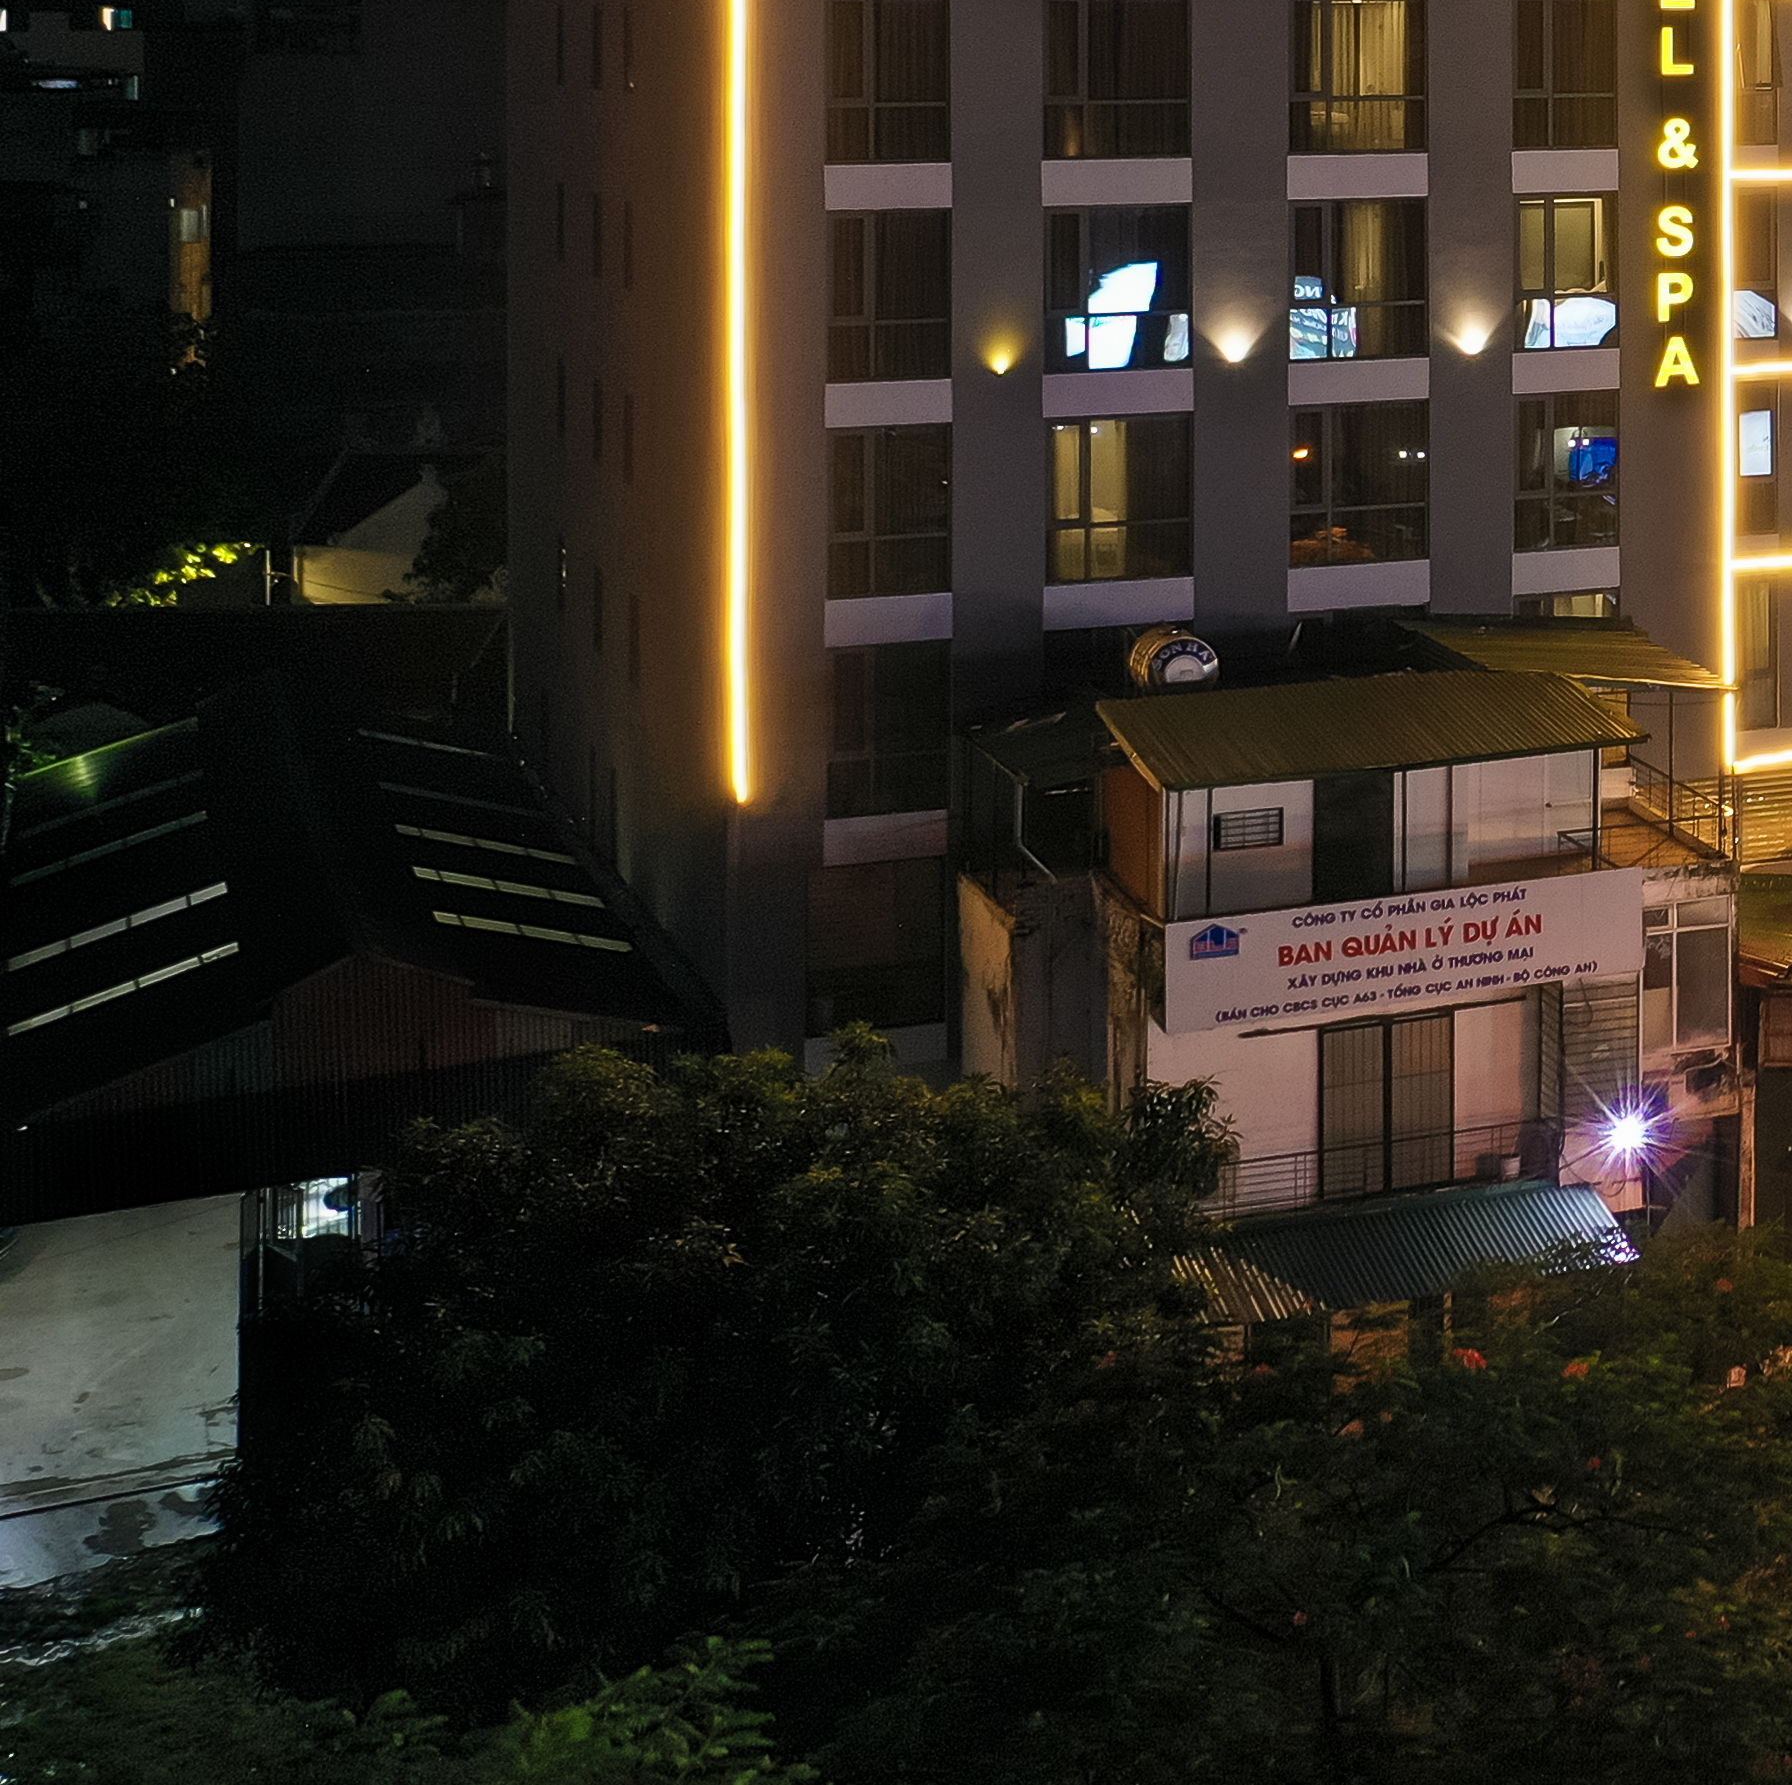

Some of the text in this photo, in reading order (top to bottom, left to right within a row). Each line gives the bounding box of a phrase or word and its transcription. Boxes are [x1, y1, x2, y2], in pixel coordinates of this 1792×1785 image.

[1656, 117, 1700, 170] &
[1655, 205, 1701, 388] SPA
[1292, 912, 1337, 928] CÔNG
[1340, 909, 1357, 924] TY
[1430, 898, 1455, 911] GIA
[1460, 892, 1489, 908] LỘC
[1493, 886, 1527, 904] PHÁT
[1278, 909, 1543, 966] BAN QUẢN LÝ DỰ ÁN
[1215, 1007, 1247, 1024] (BÁN
[1250, 1003, 1280, 1018] CHO
[1283, 998, 1318, 1014] CBCS
[1322, 994, 1350, 1009] CỤC
[1353, 990, 1378, 1005] A63
[1425, 982, 1452, 996] CỤC
[1456, 977, 1474, 991] AN
[1513, 969, 1531, 983] BỘ
[1534, 962, 1572, 979] CÔNG
[1574, 959, 1598, 974] AN)
[1287, 974, 1318, 990] XÂY
[1322, 969, 1362, 987] DỰNG
[1366, 965, 1394, 980] KHU
[1398, 958, 1427, 976] NHÀ
[1508, 946, 1534, 962] MẠI
